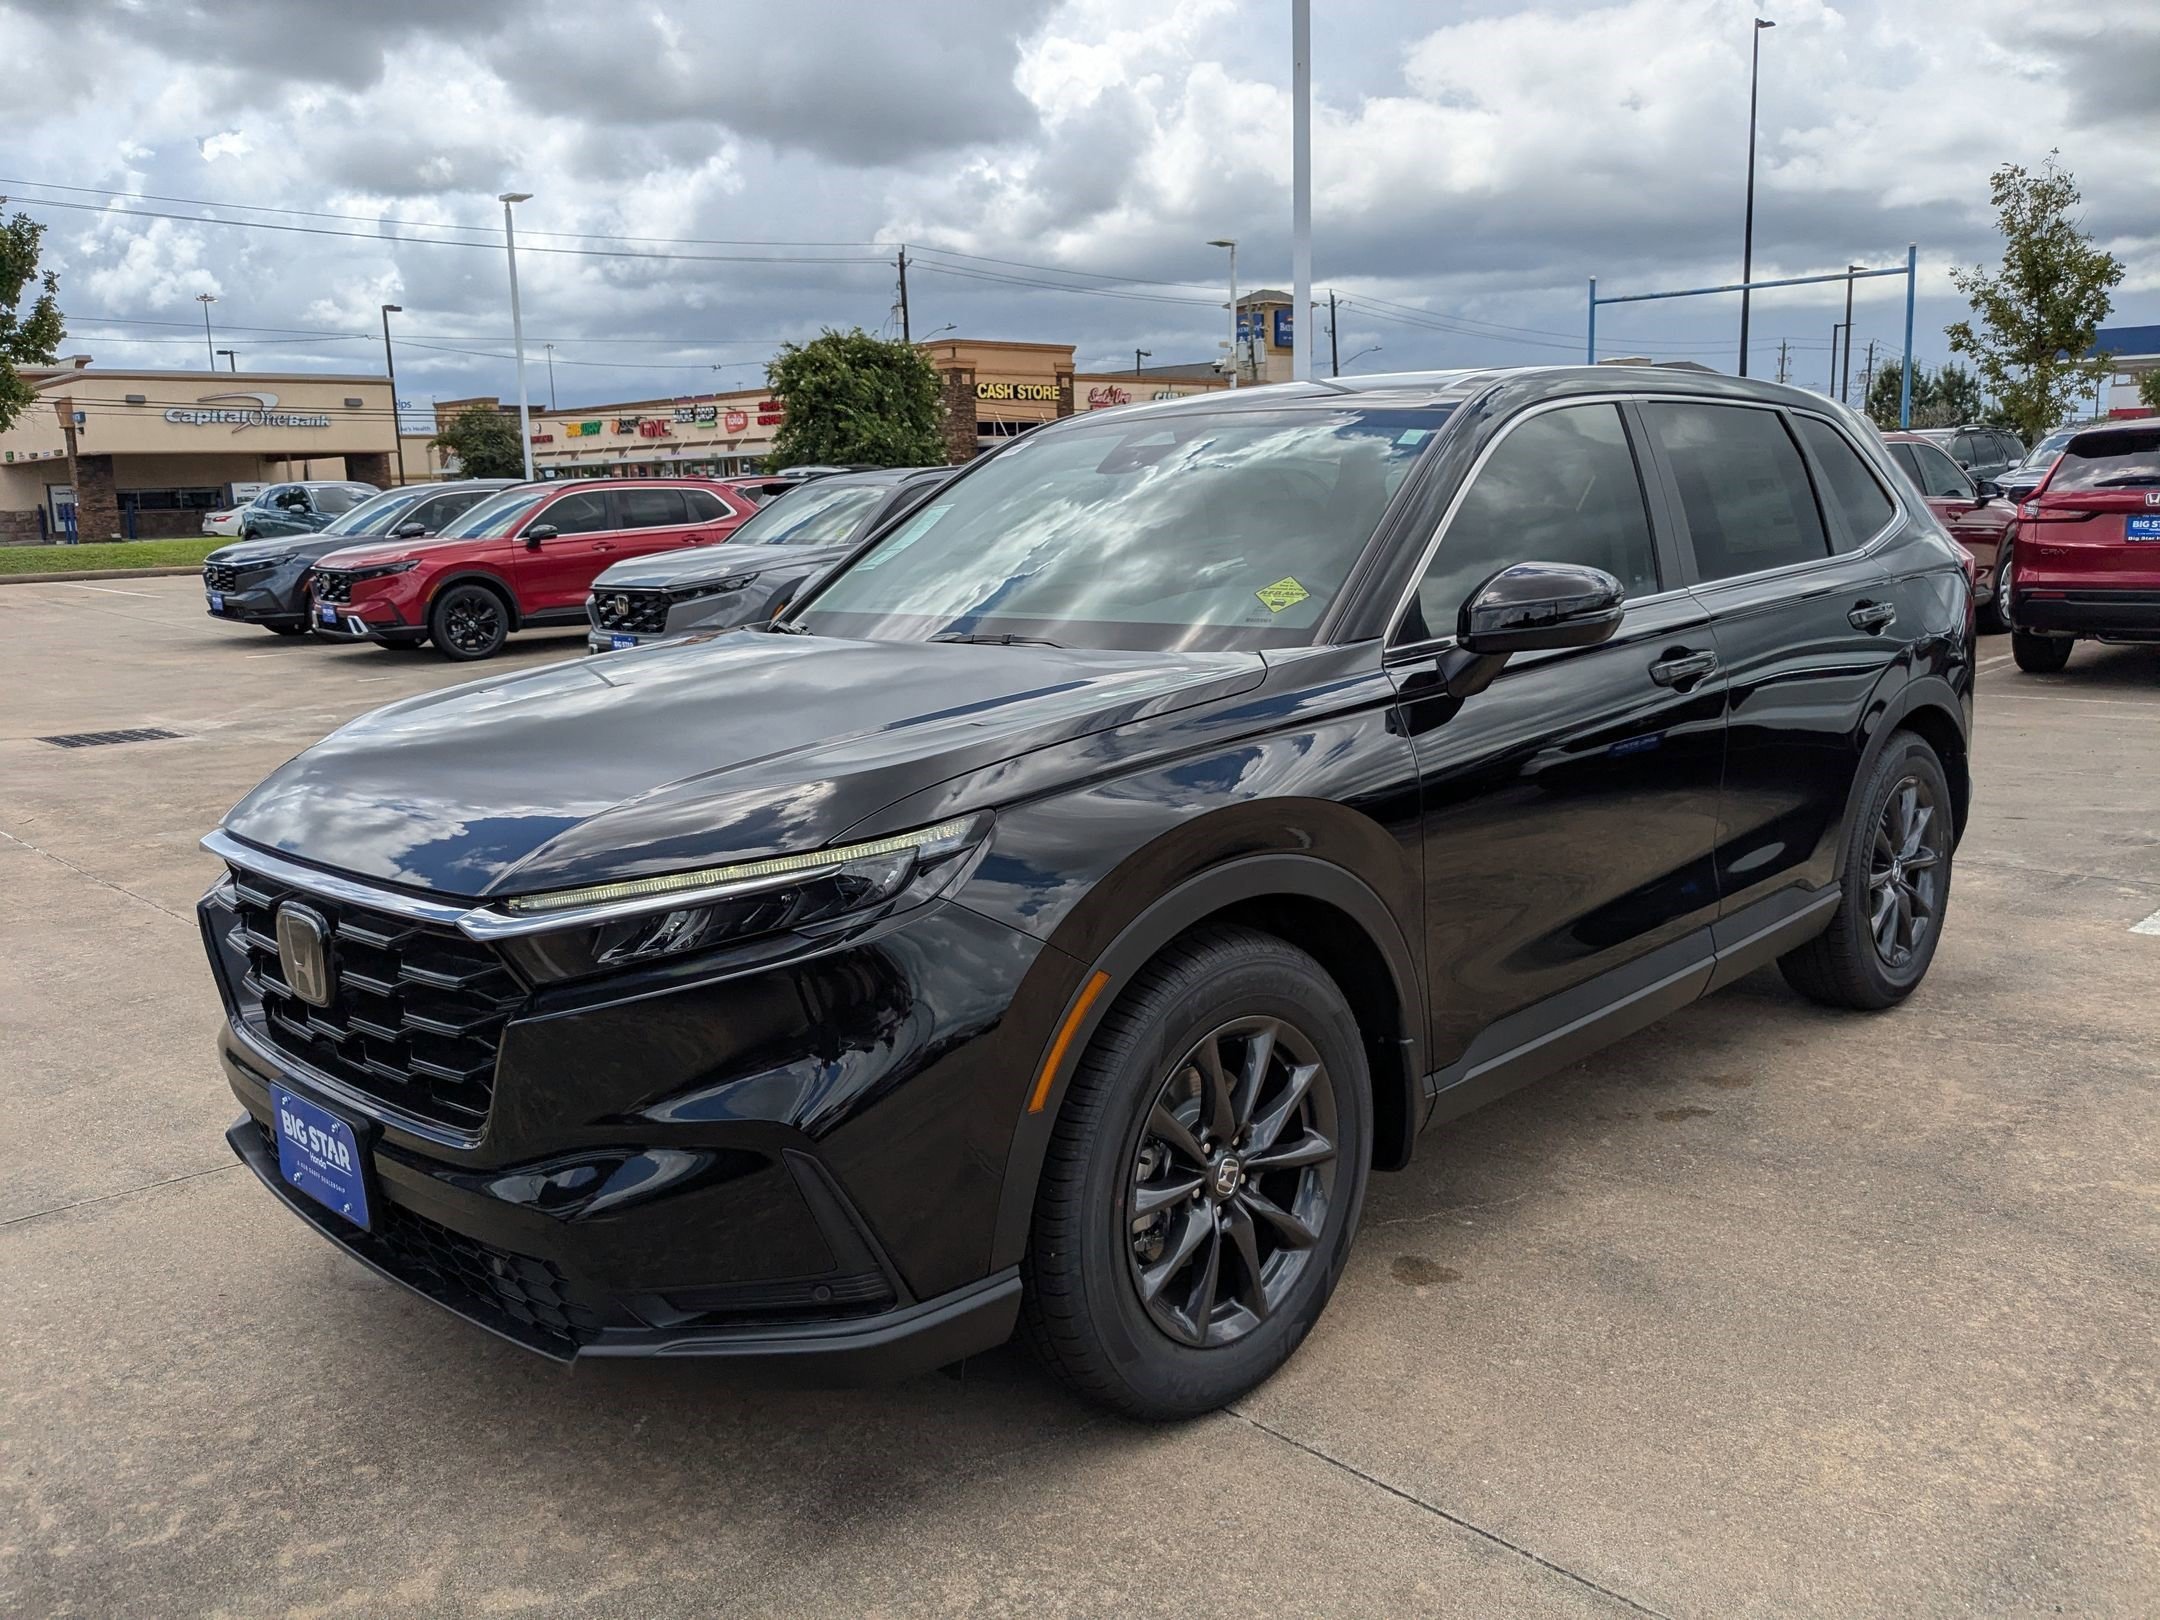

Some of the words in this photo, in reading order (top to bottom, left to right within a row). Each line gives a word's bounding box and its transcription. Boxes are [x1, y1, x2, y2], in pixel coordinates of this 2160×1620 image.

[976, 383, 1014, 400] CASH
[1016, 384, 1060, 401] STORE
[287, 415, 331, 427] Bank
[2132, 520, 2150, 528] BIG
[281, 1109, 307, 1144] BIG
[308, 1126, 352, 1171] STAR
[309, 1152, 327, 1170] Honda
